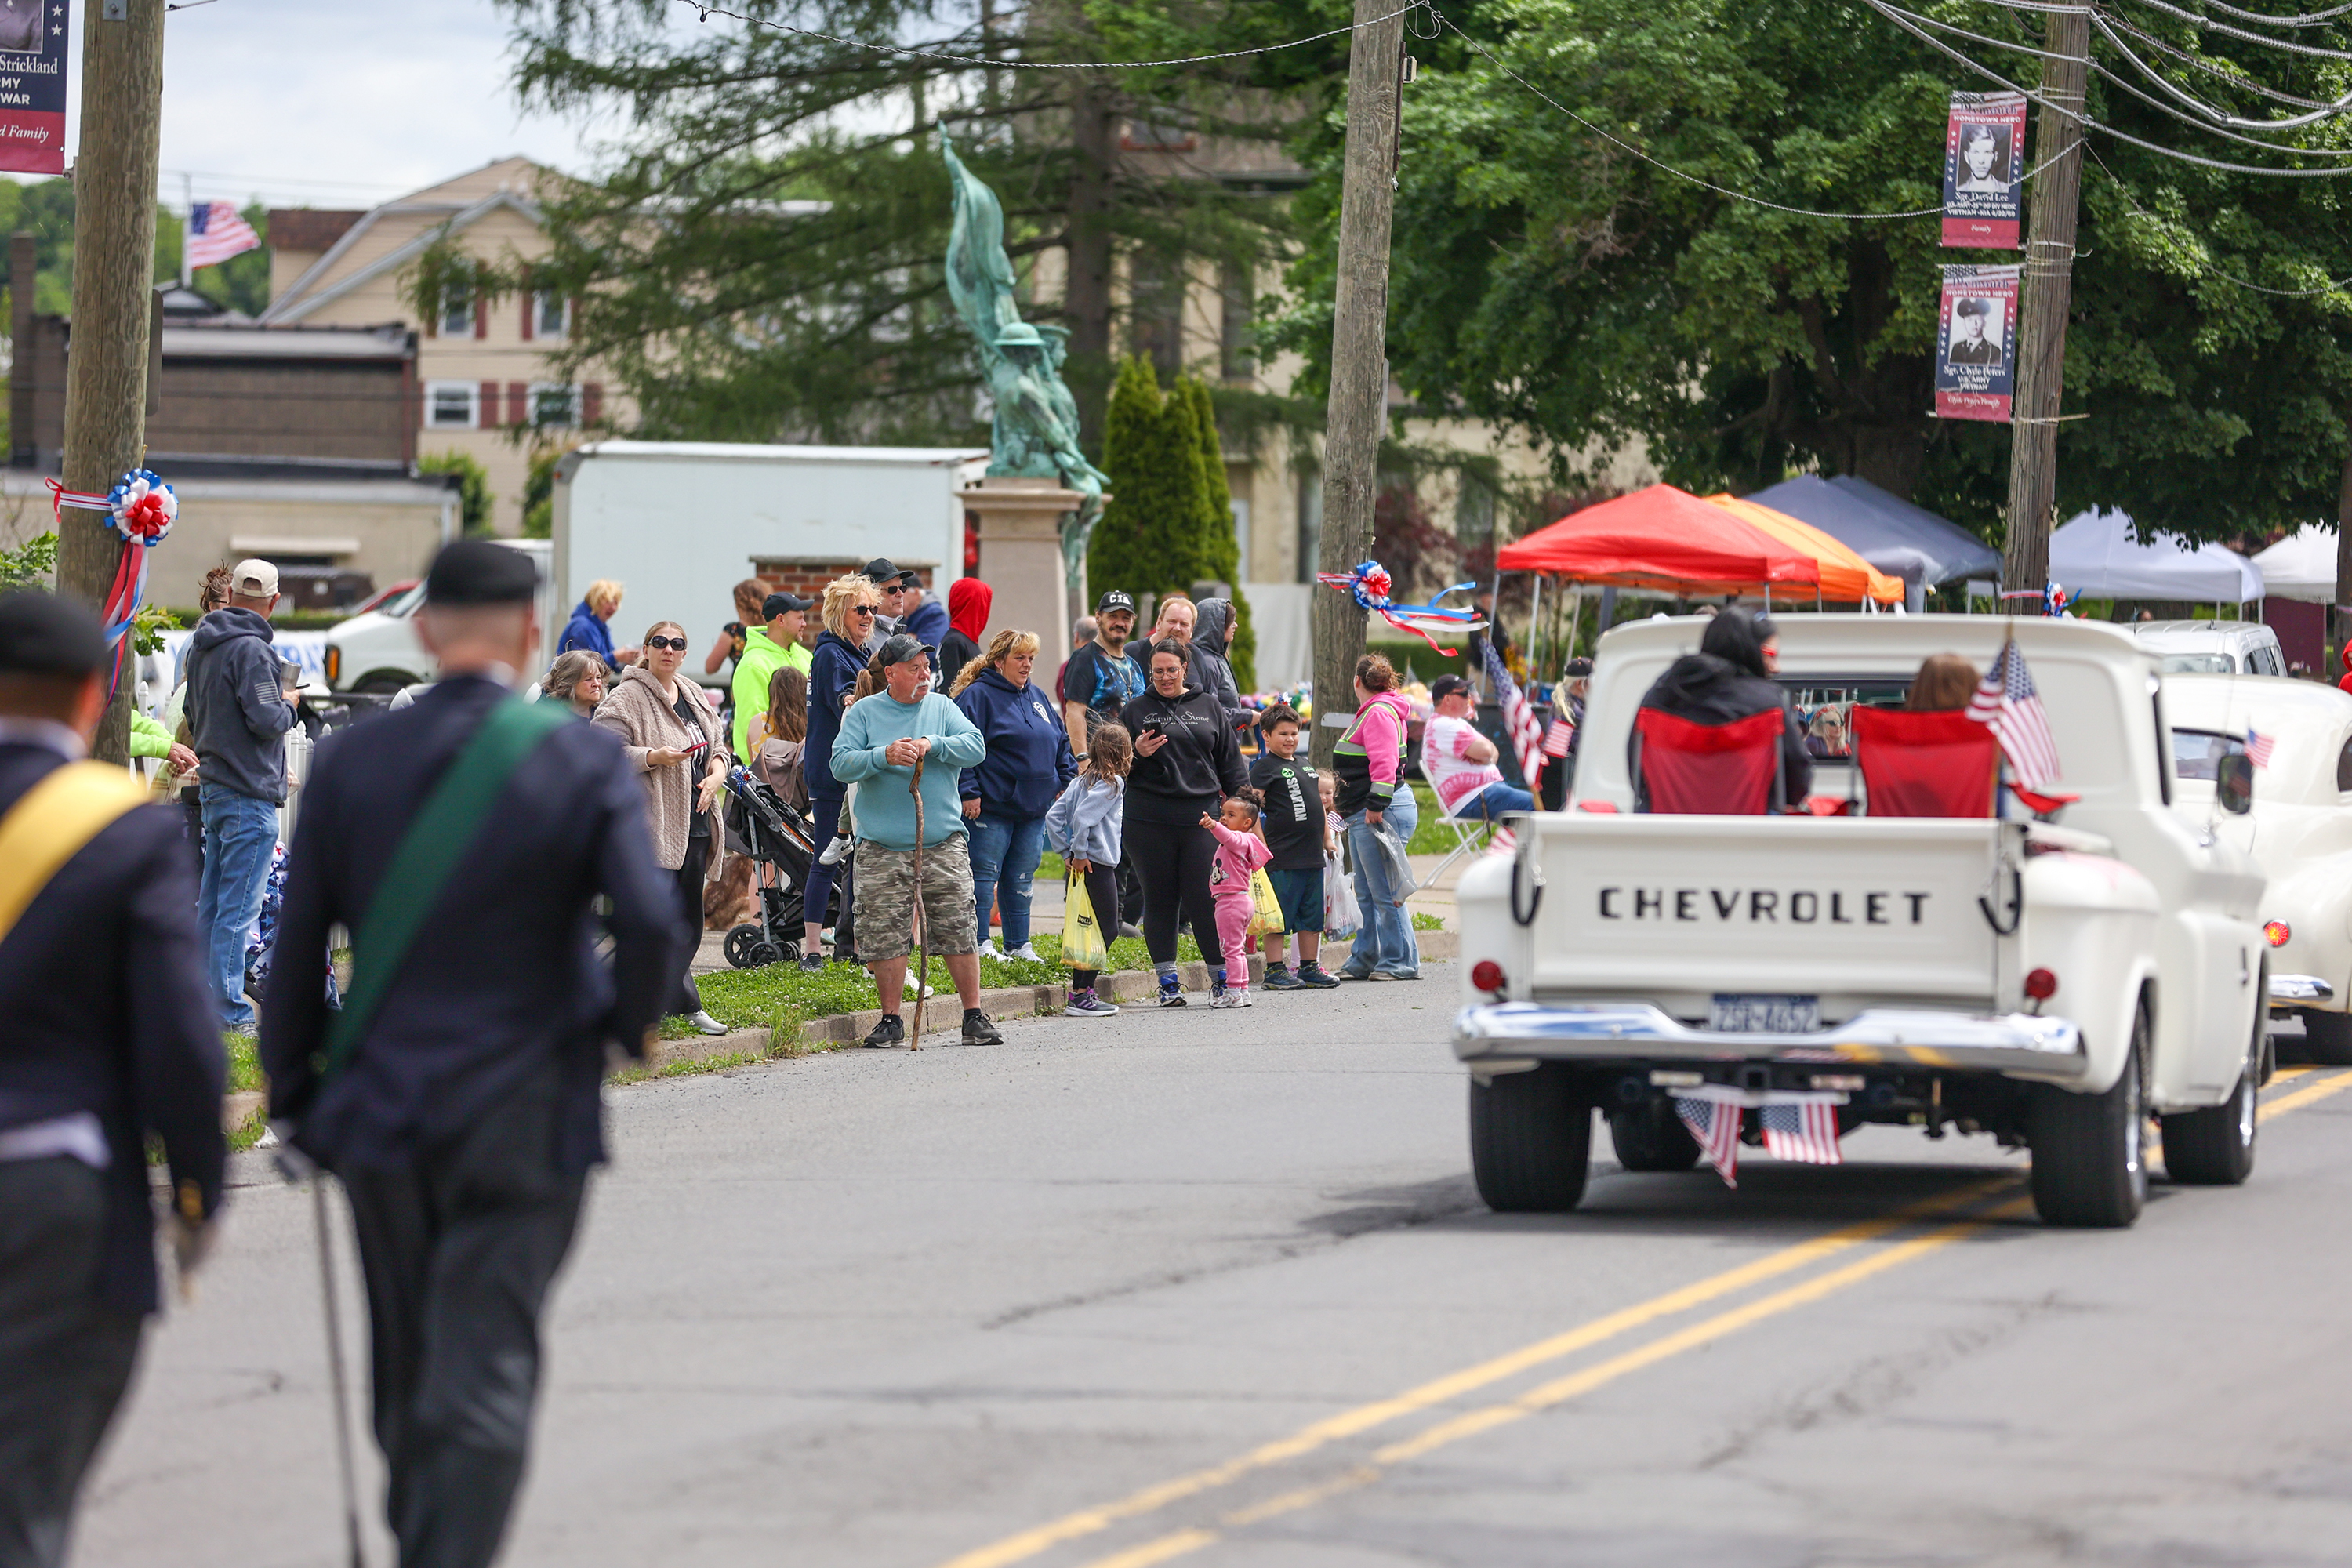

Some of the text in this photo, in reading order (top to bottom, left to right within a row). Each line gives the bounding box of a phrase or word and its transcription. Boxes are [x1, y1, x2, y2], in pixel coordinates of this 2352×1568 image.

[0, 54, 58, 74] Strickland
[0, 77, 21, 89] MY
[1, 93, 31, 105] WAR
[1960, 103, 2018, 116] Plymouth
[1953, 114, 1998, 123] HOMETOWN
[8, 125, 49, 143] Family
[1971, 191, 1994, 201] David
[1994, 192, 2009, 201] Lee
[1947, 208, 1977, 216] VIETNAM
[1971, 223, 1991, 234] Family
[1952, 276, 2010, 289] Plymouth
[1946, 289, 2014, 298] HOMETOWN HERO
[1944, 364, 2005, 377] Sgt. Clyde Peters
[1109, 593, 1131, 605] CIA
[1181, 710, 1210, 722] Stone
[1287, 776, 1308, 822] SPARTAN
[1599, 887, 1930, 925] CHEVROLET
